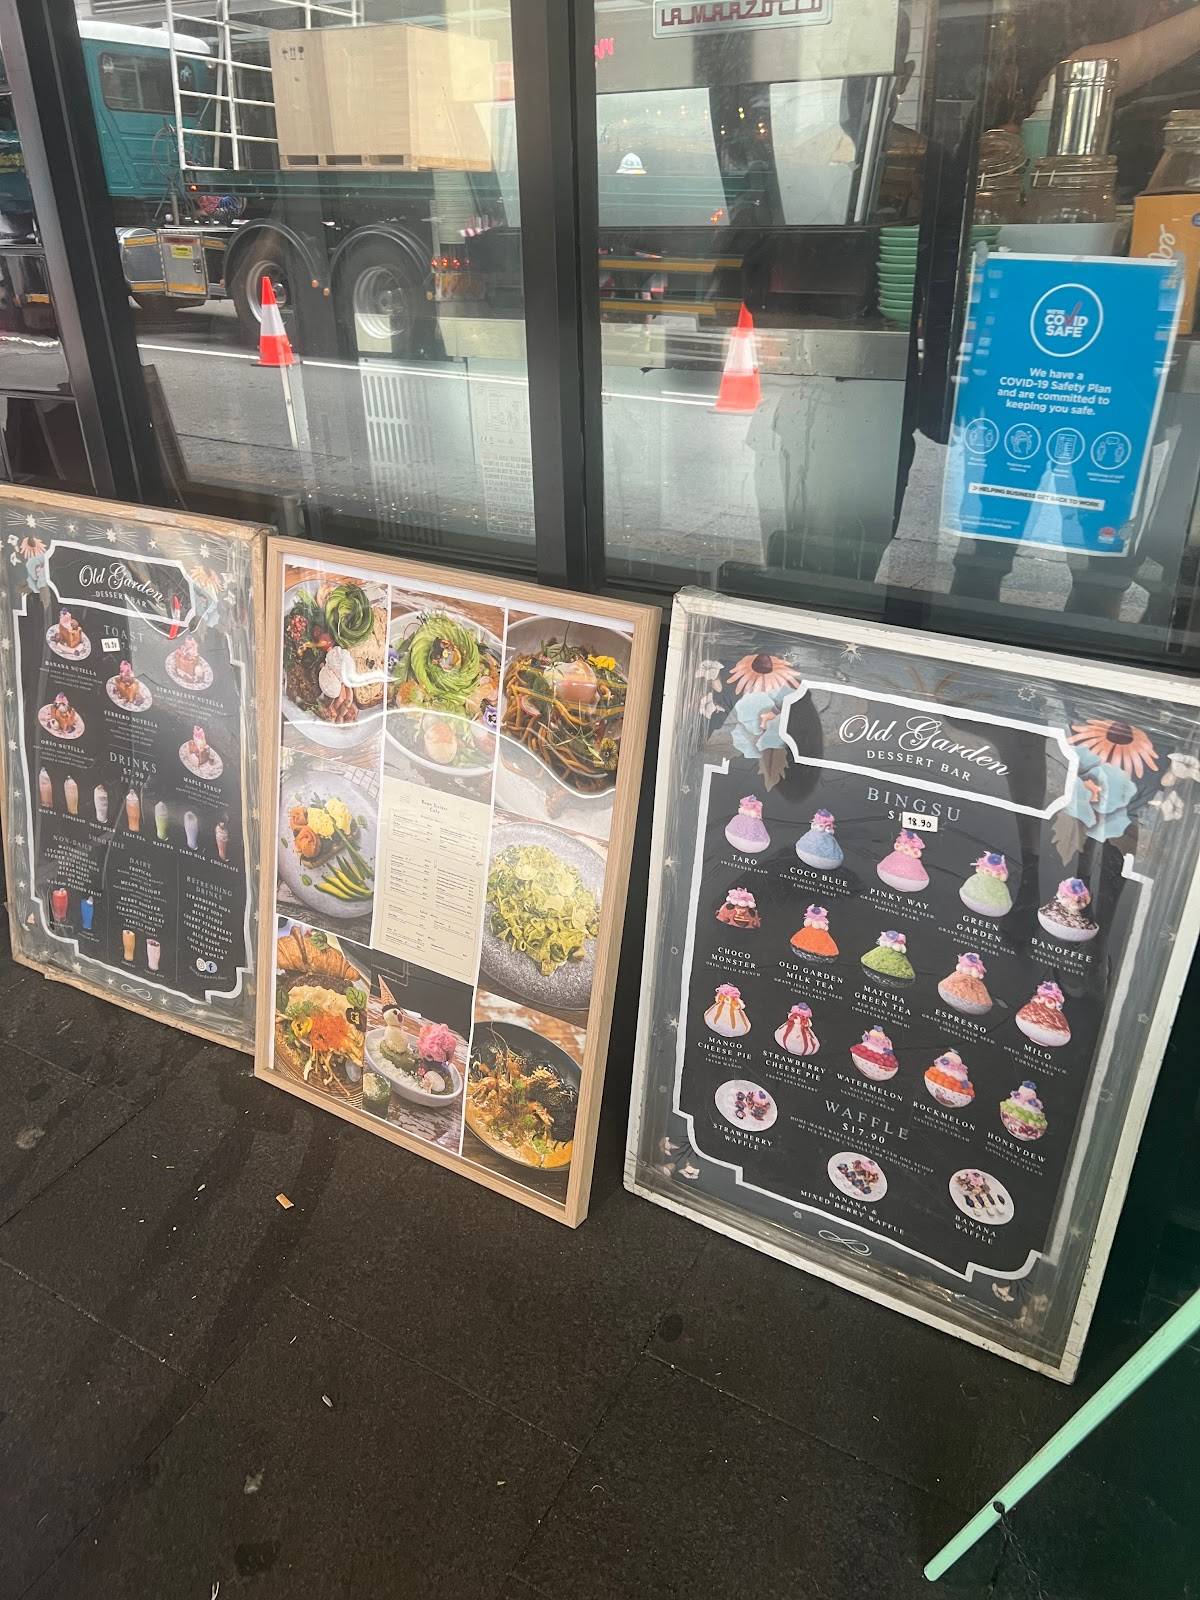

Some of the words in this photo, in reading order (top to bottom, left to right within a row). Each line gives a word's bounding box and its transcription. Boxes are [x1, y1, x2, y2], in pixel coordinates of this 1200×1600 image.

[1044, 312, 1089, 327] COVID
[1045, 325, 1084, 338] SAFE
[1000, 376, 1049, 389] COVID-19
[1051, 381, 1086, 394] Safety
[1087, 383, 1112, 394] Plan
[1030, 368, 1047, 378] We
[1049, 369, 1075, 380] have
[1077, 372, 1085, 381] a
[997, 388, 1017, 397] and
[1018, 390, 1035, 399] are
[1037, 392, 1097, 405] committed
[1098, 396, 1111, 405] to
[1005, 399, 1047, 413] keeping
[1049, 404, 1068, 414] you
[1071, 405, 1097, 416] safe.
[79, 565, 105, 587] Old
[108, 562, 165, 603] Garden
[104, 625, 144, 642] TOAST
[839, 714, 897, 744] Old
[898, 715, 1010, 776] Garden
[109, 752, 157, 774] DRINKS
[867, 750, 934, 768] DESSERT
[940, 763, 971, 782] BAR
[867, 787, 961, 822] BINGSU
[732, 855, 758, 866] TARO
[789, 866, 818, 879] COCO
[821, 874, 849, 888] BLUE
[870, 888, 903, 903] PINKY
[907, 899, 930, 910] WAY
[956, 923, 1003, 943] GARDEN
[962, 915, 1000, 932] GREEN
[717, 946, 751, 960] CHOCO
[1031, 937, 1094, 963] BANOFFEE
[711, 953, 757, 970] MONSTER
[779, 961, 799, 971] OLD
[802, 967, 844, 984] GARDEN
[786, 972, 811, 984] MILK
[815, 980, 834, 991] TEA
[854, 991, 888, 1007] GREEN
[892, 1003, 911, 1016] TEA
[863, 985, 905, 1004] MATCHA
[935, 1008, 987, 1034] ESPRESSO
[697, 1042, 733, 1055] CHEESE
[737, 1051, 752, 1060] PIE
[708, 1036, 743, 1049] MANGO
[1023, 1043, 1052, 1060] MILO
[763, 1050, 826, 1074] STRAWBERRY
[765, 1060, 801, 1075] CHEESE
[805, 1071, 821, 1081] PIE
[837, 1073, 904, 1102] WATERMELON
[825, 1100, 910, 1140] WAFFLE
[912, 1101, 976, 1131] ROCKMELON
[713, 1123, 773, 1147] STRAWBERRY
[724, 1135, 760, 1151] WAFFLE
[842, 1122, 885, 1144] $17.90
[987, 1131, 1046, 1163] HONEYDEW
[800, 1190, 831, 1205] MIXED
[833, 1202, 865, 1218] BERRY
[868, 1215, 905, 1235] WAFFLE
[828, 1192, 868, 1211] BANANA
[955, 1214, 996, 1237] BANANA
[955, 1223, 993, 1245] WAFFLE
